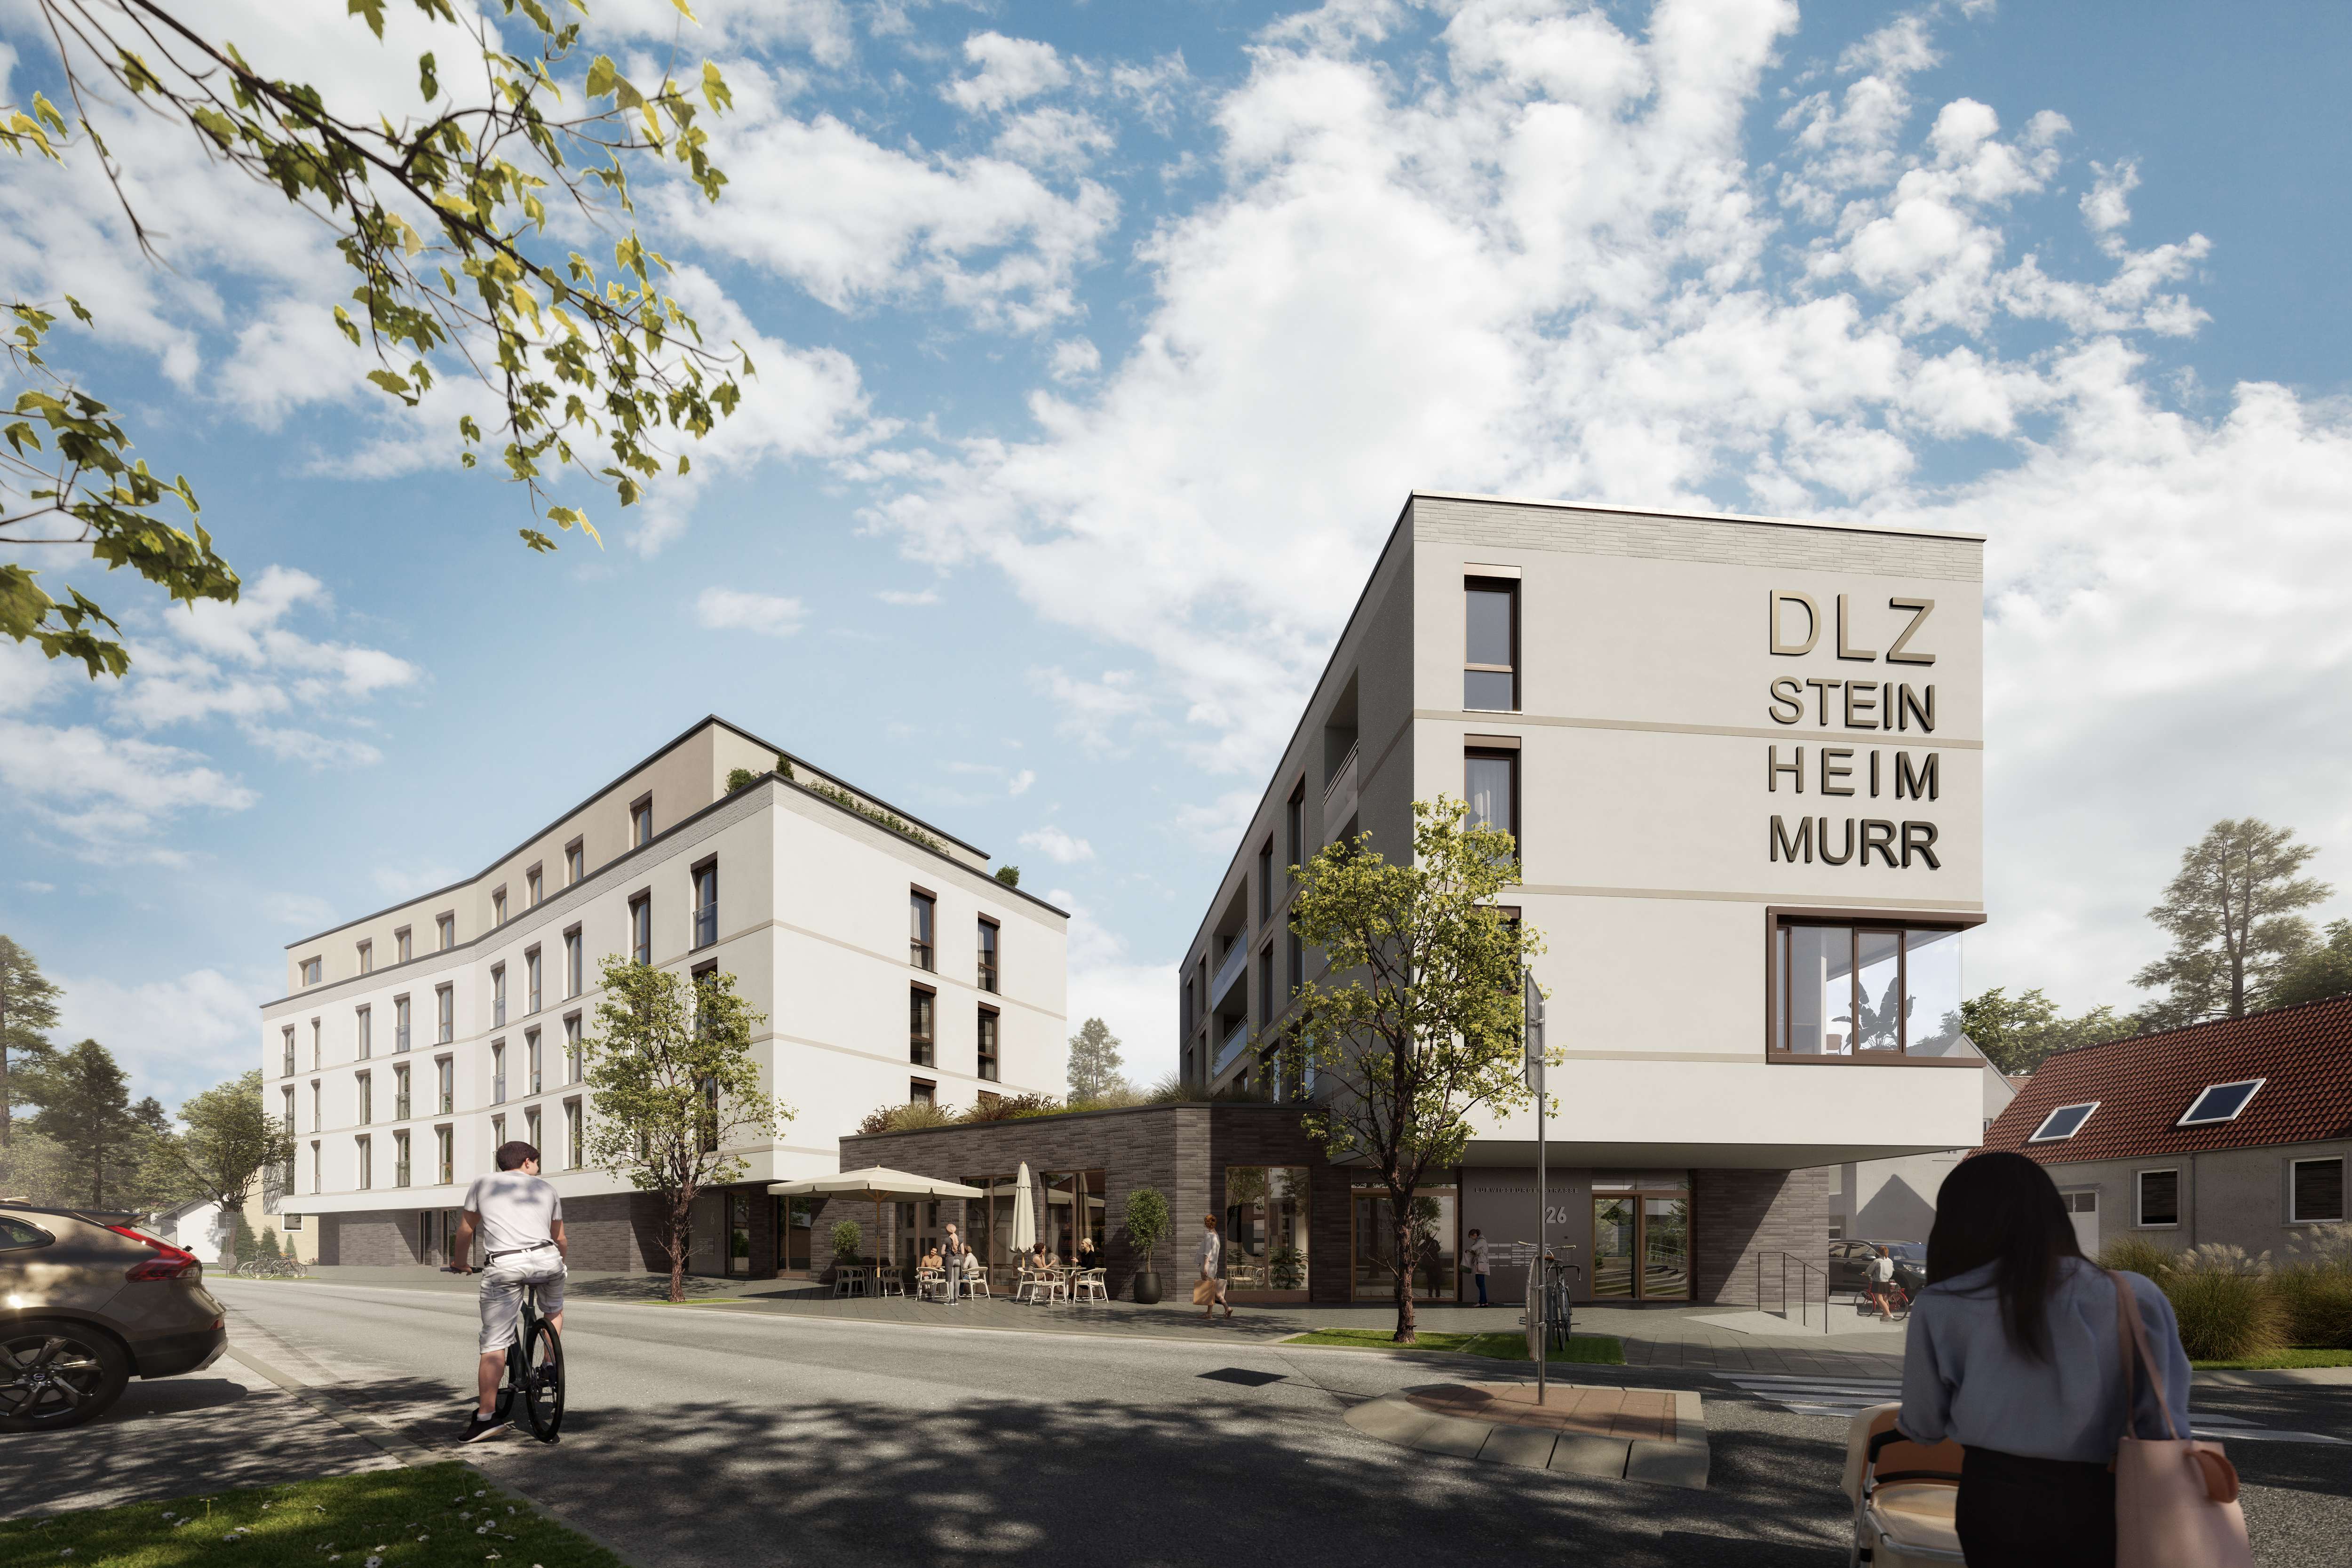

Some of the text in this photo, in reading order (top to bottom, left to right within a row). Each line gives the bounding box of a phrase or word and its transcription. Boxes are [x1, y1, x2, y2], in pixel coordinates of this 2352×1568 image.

[1770, 589, 1936, 665] DLZ
[1769, 676, 1935, 733] STEIN
[1769, 745, 1939, 802] HEIM
[1770, 815, 1941, 870] MURR
[1545, 1207, 1567, 1224] 26
